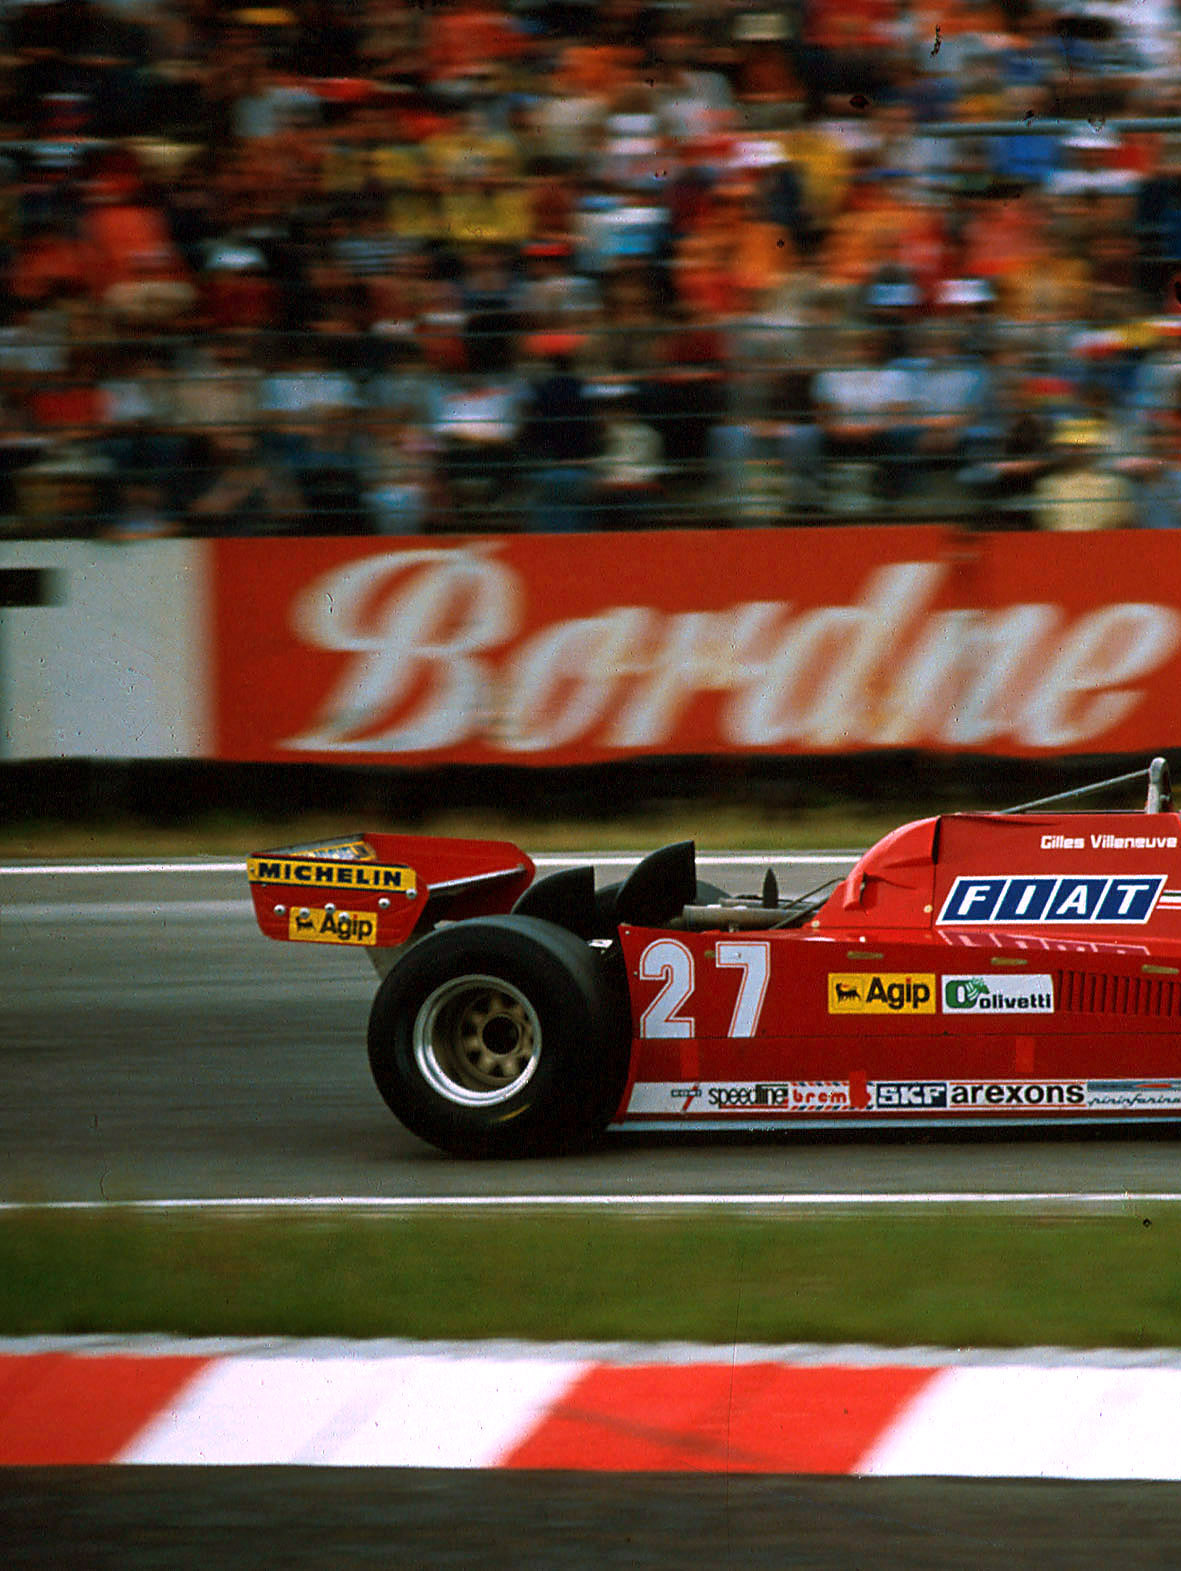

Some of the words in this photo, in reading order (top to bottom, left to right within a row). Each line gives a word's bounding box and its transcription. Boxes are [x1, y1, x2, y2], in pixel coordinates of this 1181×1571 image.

[1041, 835, 1084, 849] Gilles
[1090, 834, 1178, 849] Villeneuve
[258, 862, 402, 887] MICHELIN
[957, 884, 1149, 915] FIAT
[320, 912, 373, 940] Agip
[639, 938, 770, 1038] 27
[866, 976, 930, 1010] Agip
[979, 993, 1051, 1009] olivetti
[878, 1085, 944, 1105] SKF
[950, 1084, 1085, 1105] arexons
